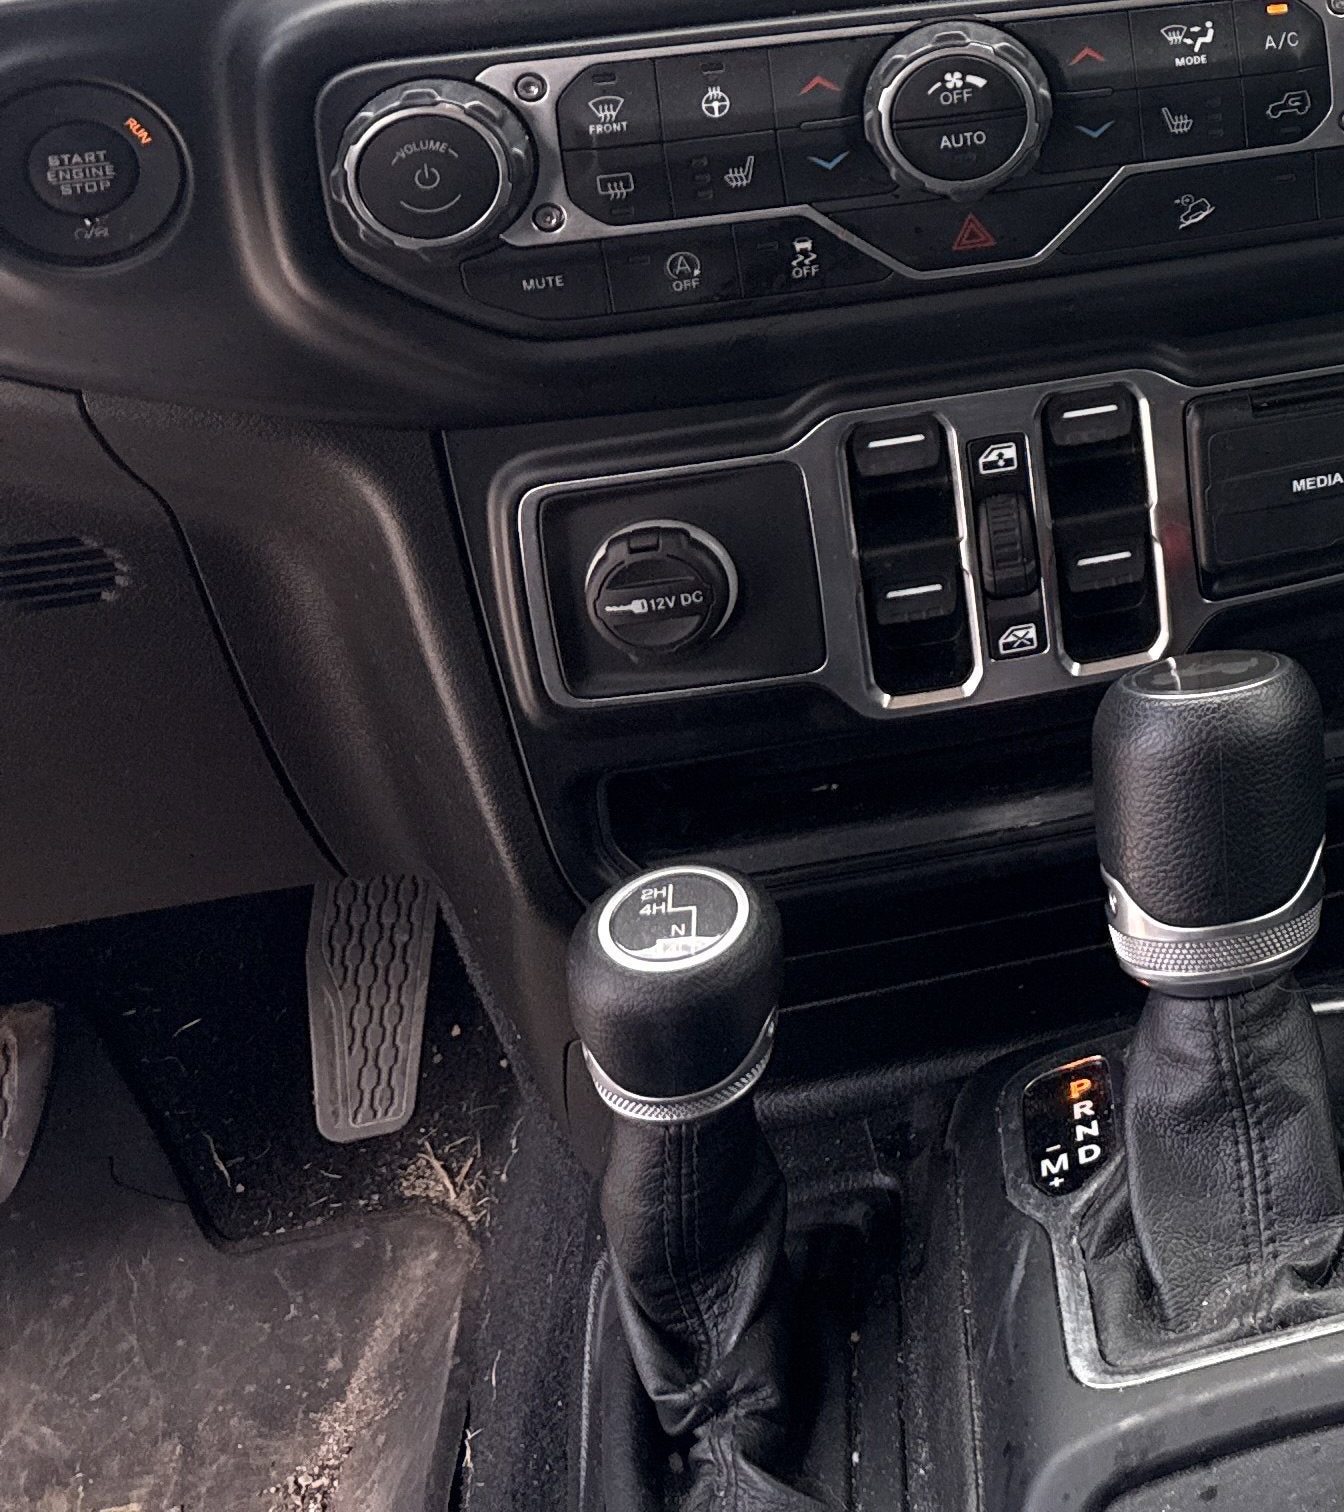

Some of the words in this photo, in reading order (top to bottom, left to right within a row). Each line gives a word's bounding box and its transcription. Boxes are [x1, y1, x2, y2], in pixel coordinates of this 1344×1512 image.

[1264, 31, 1300, 50] A/C
[1174, 55, 1208, 67] MODE
[940, 88, 973, 105] OFF
[125, 117, 152, 144] RUN
[588, 121, 628, 135] FRONT
[940, 130, 987, 150] AUTO
[396, 139, 448, 160] VOLUME
[48, 151, 107, 166] START
[48, 165, 115, 181] ENGINE
[61, 182, 110, 195] STOP
[791, 264, 820, 280] OFF
[522, 274, 565, 291] MUTE
[671, 278, 701, 292] OFF
[1291, 472, 1344, 493] MEDIA
[649, 595, 676, 611] 12V
[680, 590, 704, 607] DC
[640, 887, 667, 902] 2H
[639, 903, 666, 916] 4H
[671, 924, 686, 936] N
[1069, 1079, 1091, 1098] P
[1073, 1099, 1095, 1120] R
[1075, 1120, 1099, 1142] N
[1077, 1144, 1101, 1165] D
[1040, 1152, 1069, 1177] M
